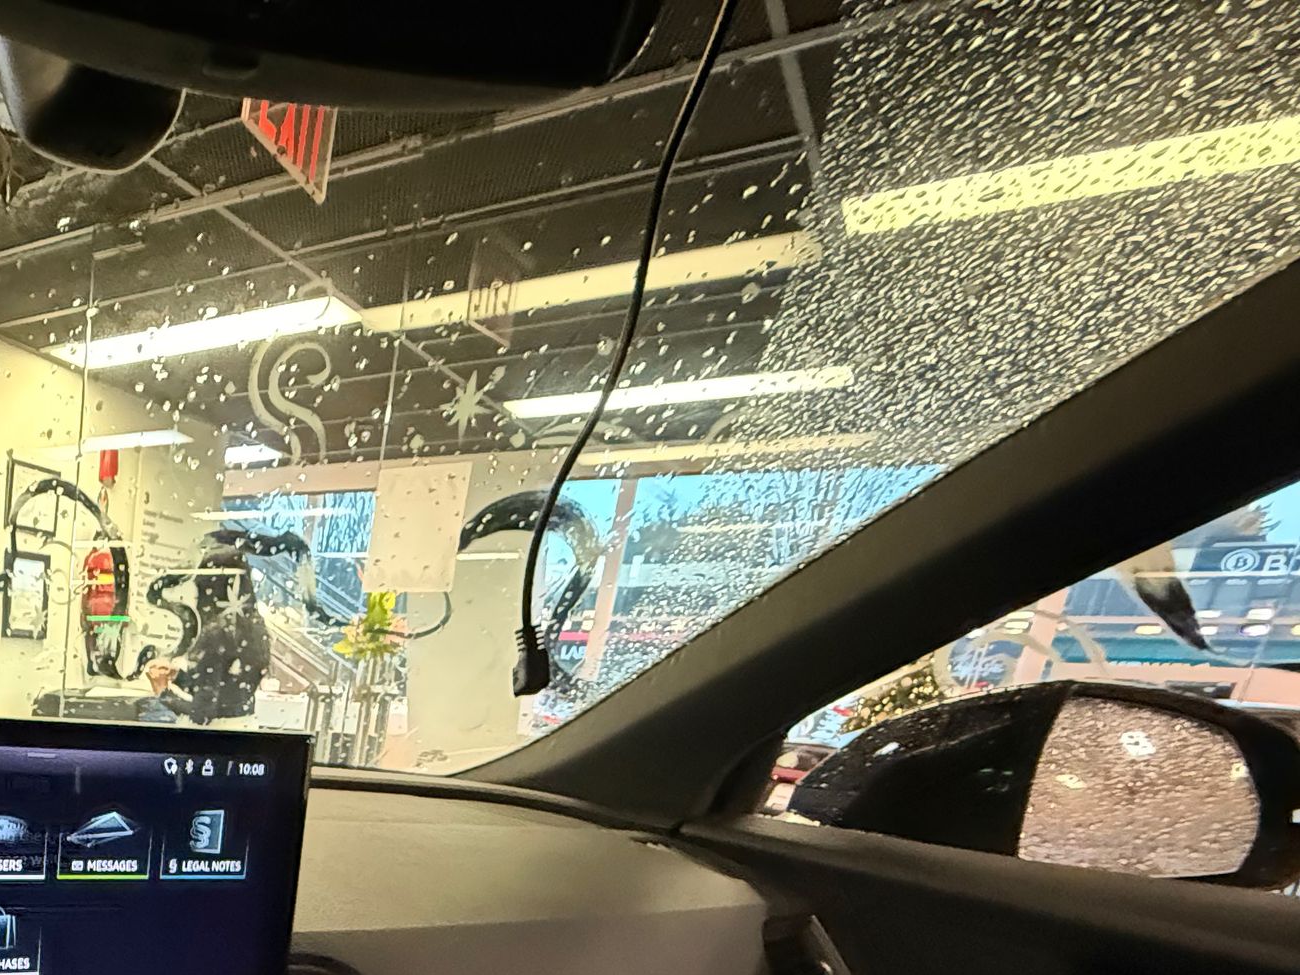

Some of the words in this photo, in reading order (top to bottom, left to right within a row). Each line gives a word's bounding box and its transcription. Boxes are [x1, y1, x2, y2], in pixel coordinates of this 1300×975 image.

[239, 763, 265, 776] 10:08
[87, 858, 138, 872] MESSAGES
[182, 860, 211, 872] LEGAL
[212, 859, 242, 872] NOTES
